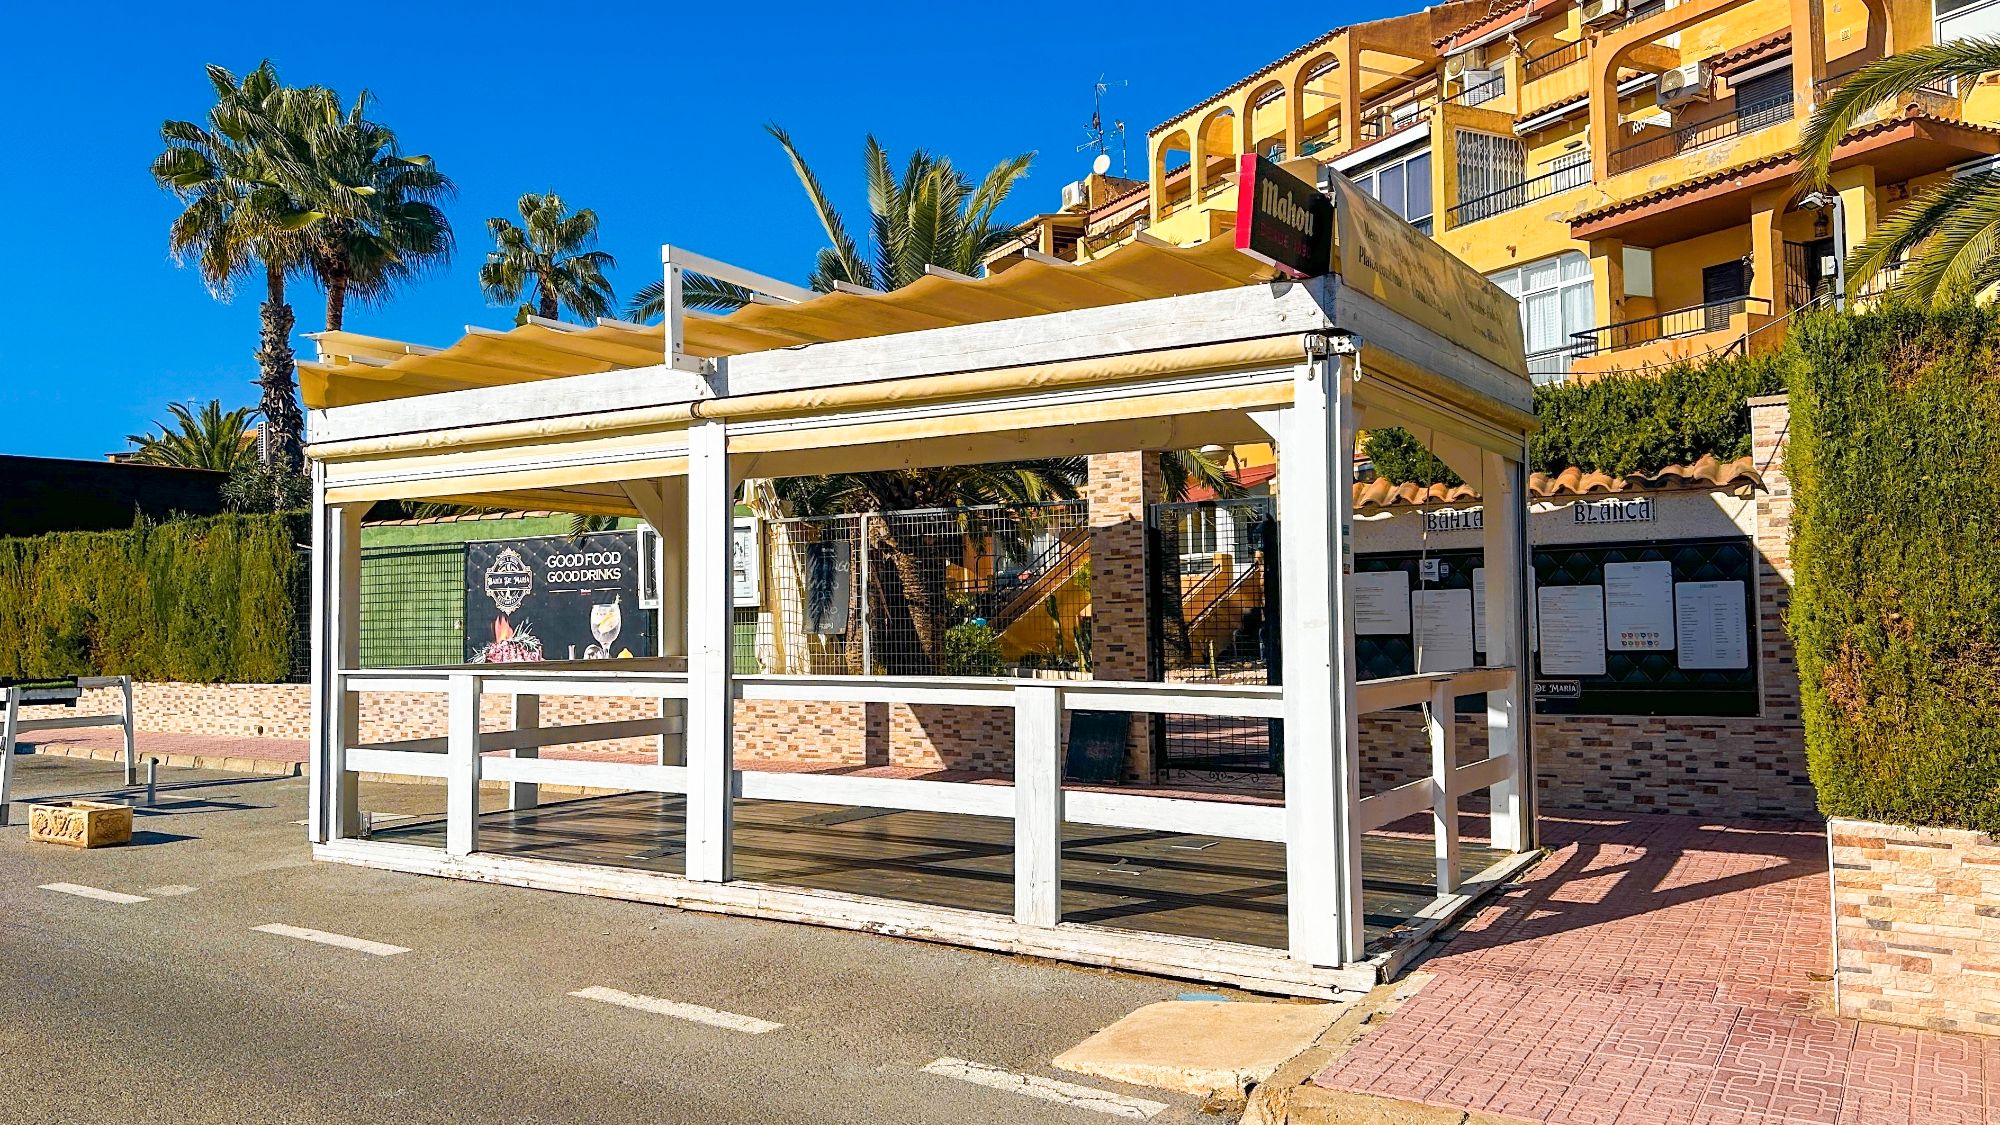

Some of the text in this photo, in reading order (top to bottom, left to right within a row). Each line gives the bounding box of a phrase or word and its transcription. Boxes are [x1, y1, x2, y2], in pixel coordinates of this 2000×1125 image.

[1262, 177, 1314, 237] Mahou
[1427, 501, 1650, 529] BAHIA BLANCA
[547, 551, 621, 568] GOOD FOOD
[547, 567, 621, 583] GOOD DRINKS
